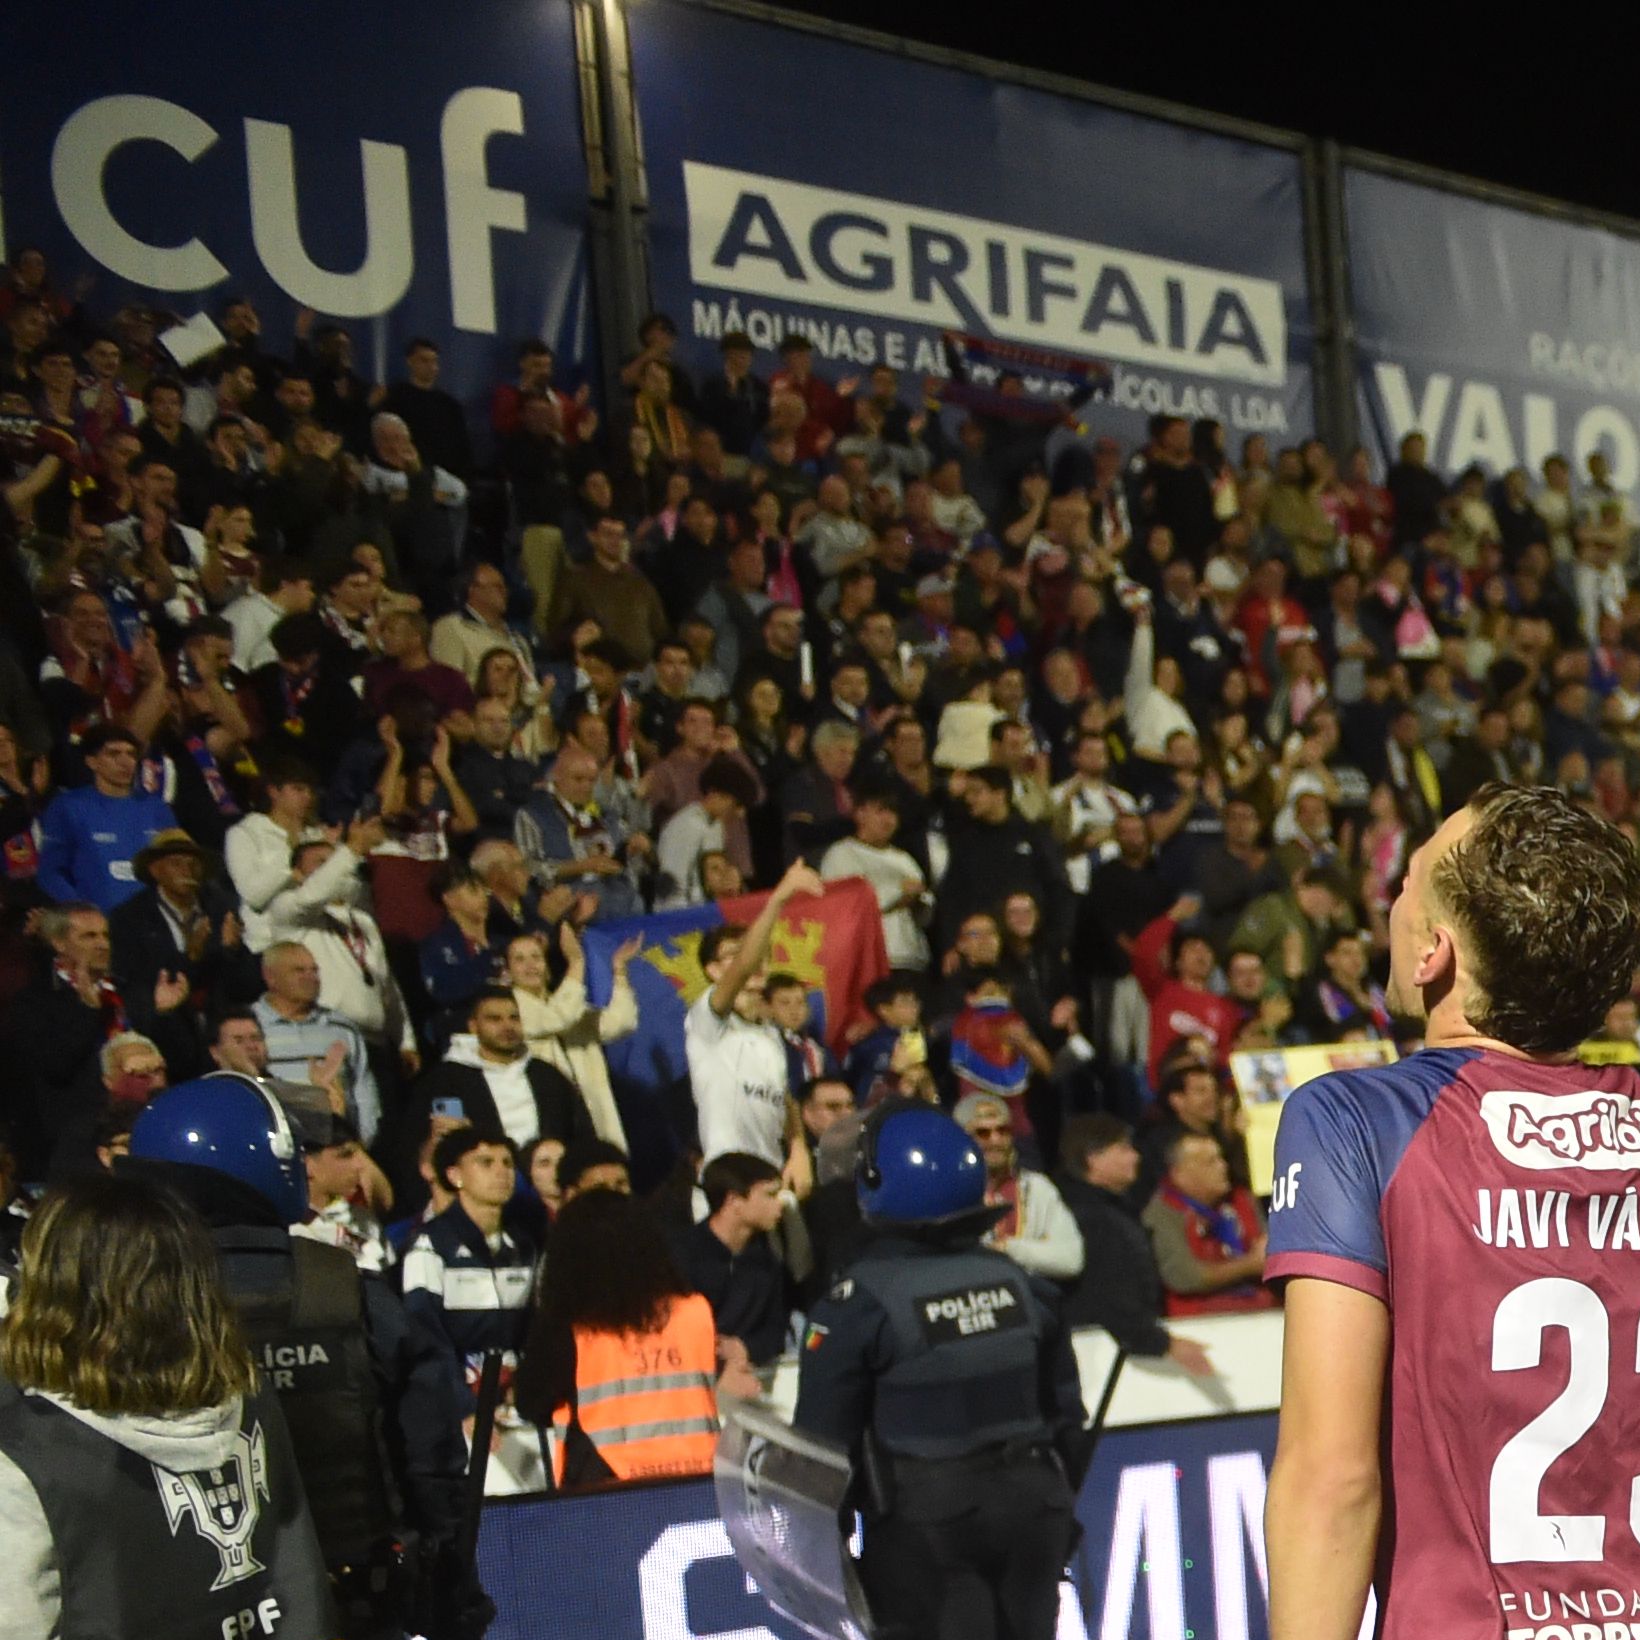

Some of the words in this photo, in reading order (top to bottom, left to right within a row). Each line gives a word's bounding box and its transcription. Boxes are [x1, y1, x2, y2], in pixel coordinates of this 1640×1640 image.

[712, 192, 1269, 366] AGRIFAIA
[882, 333, 907, 369] E
[1268, 1162, 1302, 1214] uf
[1472, 1188, 1571, 1249] JAVI
[925, 1287, 1017, 1323] POLÍCIA
